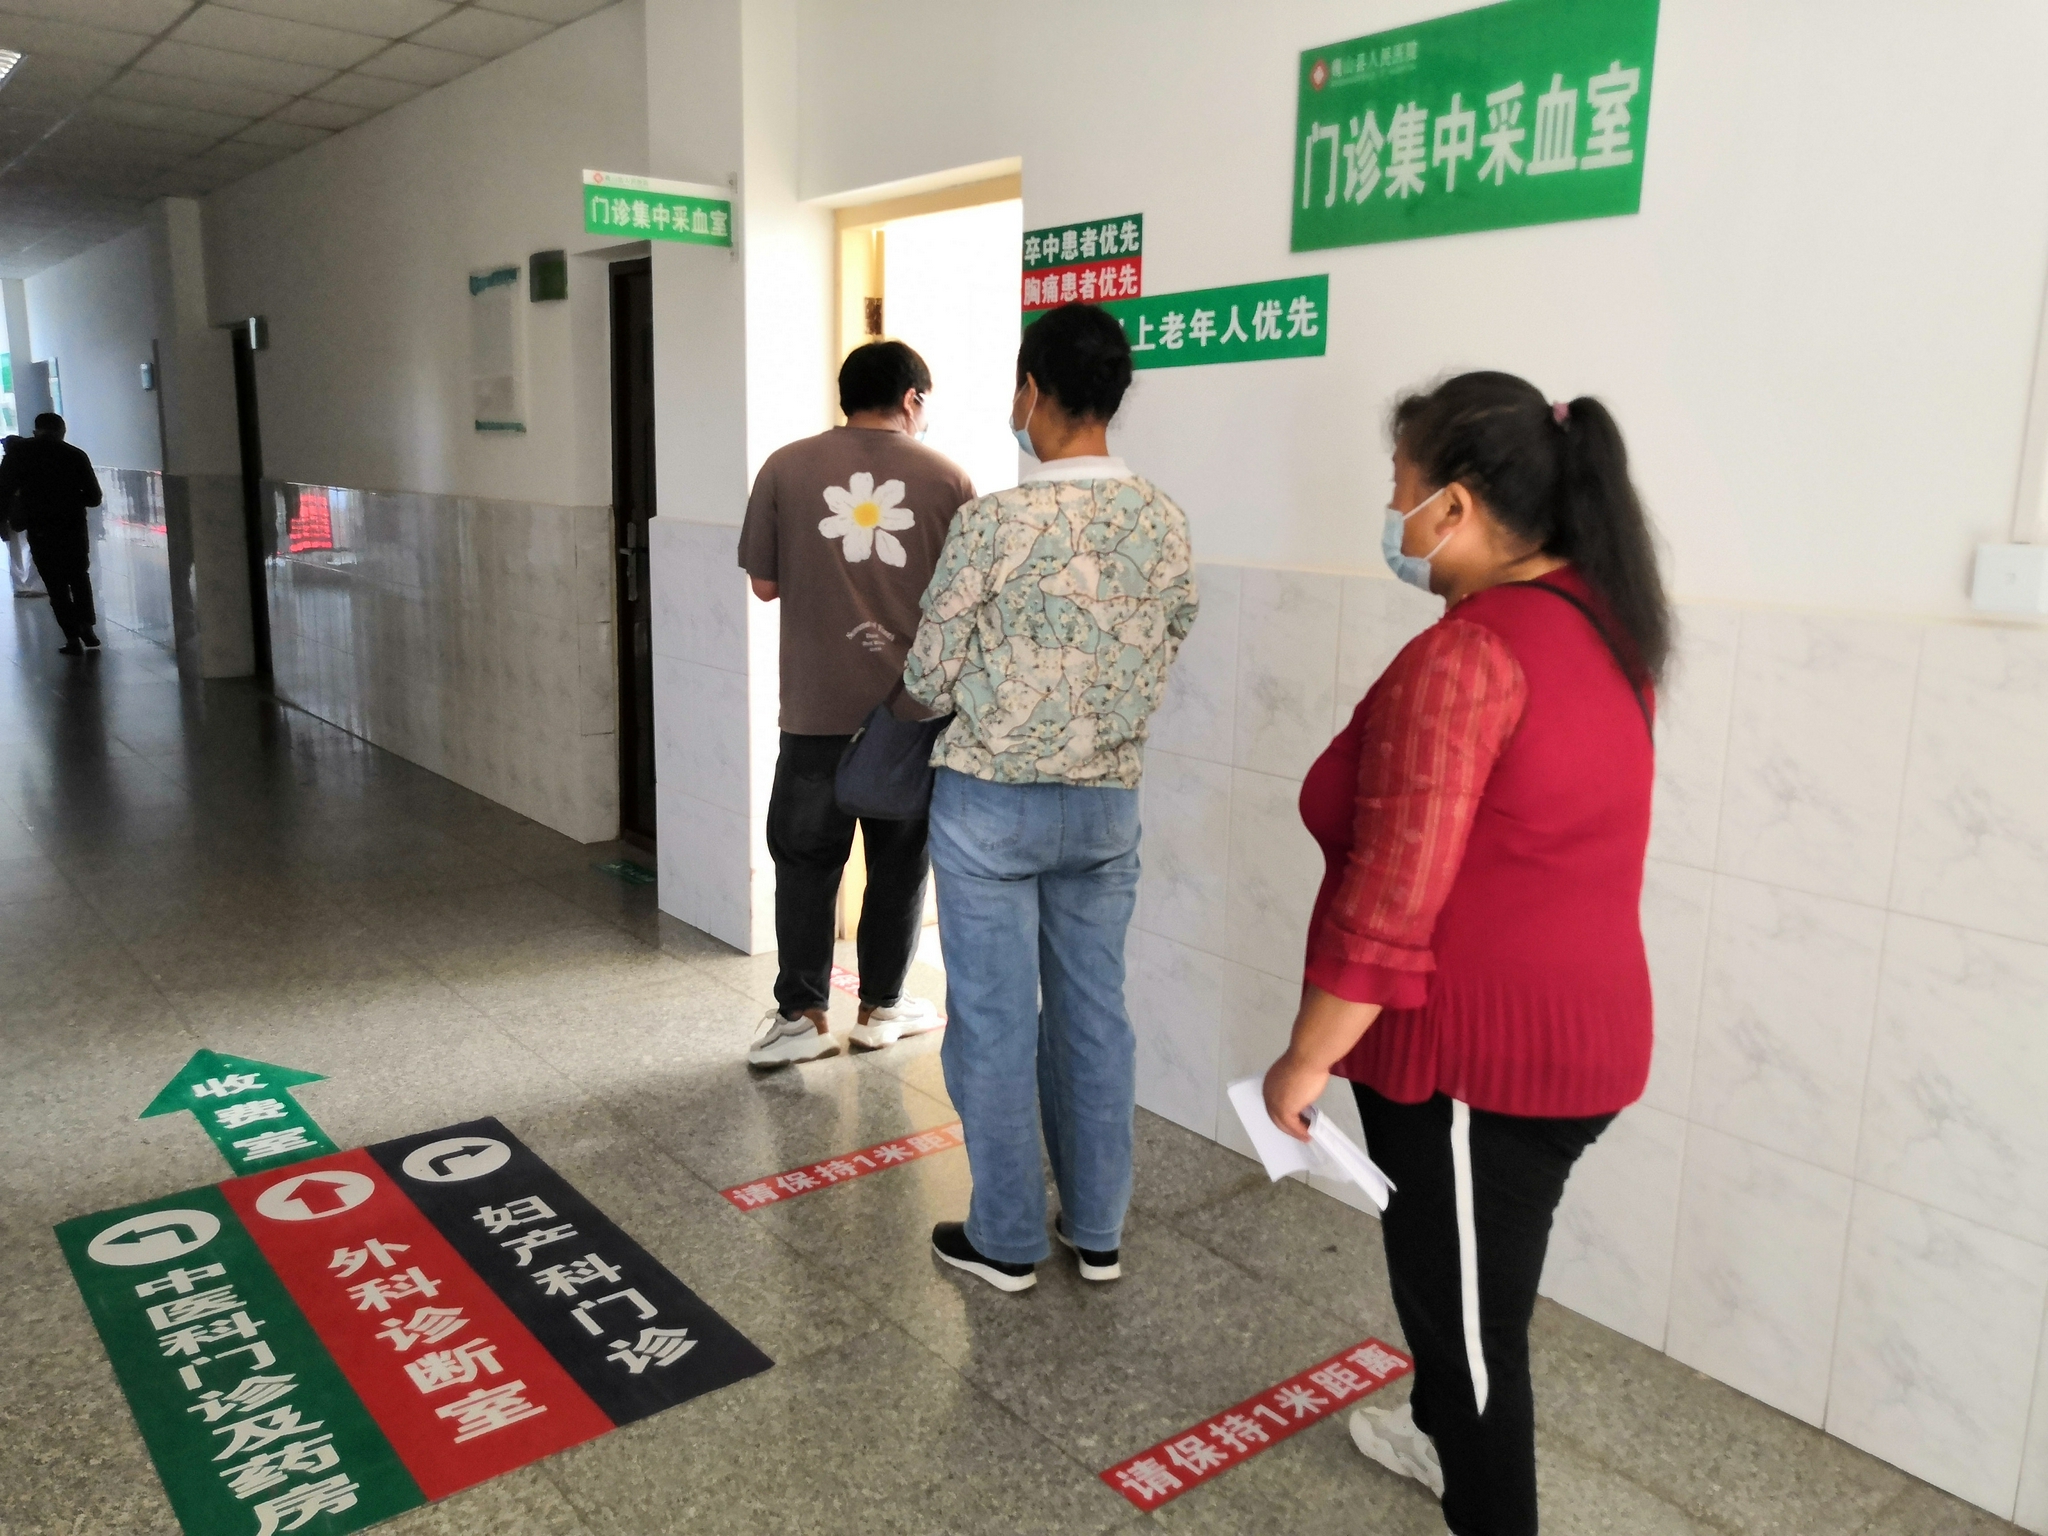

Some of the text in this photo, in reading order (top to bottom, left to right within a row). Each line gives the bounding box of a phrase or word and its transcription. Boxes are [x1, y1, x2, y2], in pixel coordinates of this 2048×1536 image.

[1302, 59, 1641, 210] 门诊集中采血室
[591, 195, 728, 237] 门诊集中采血室
[1024, 220, 1140, 266] 卒中患者优先
[1023, 263, 1138, 306] 胸痛患者优先
[1118, 296, 1319, 351] 上老年人优先
[191, 1073, 318, 1162] 收费室
[328, 1238, 547, 1443] 外科诊断室
[472, 1195, 698, 1374] 妇产科门诊
[135, 1262, 360, 1536] 中医科门诊及药房
[1116, 1343, 1408, 1500] 请保持1米距离
